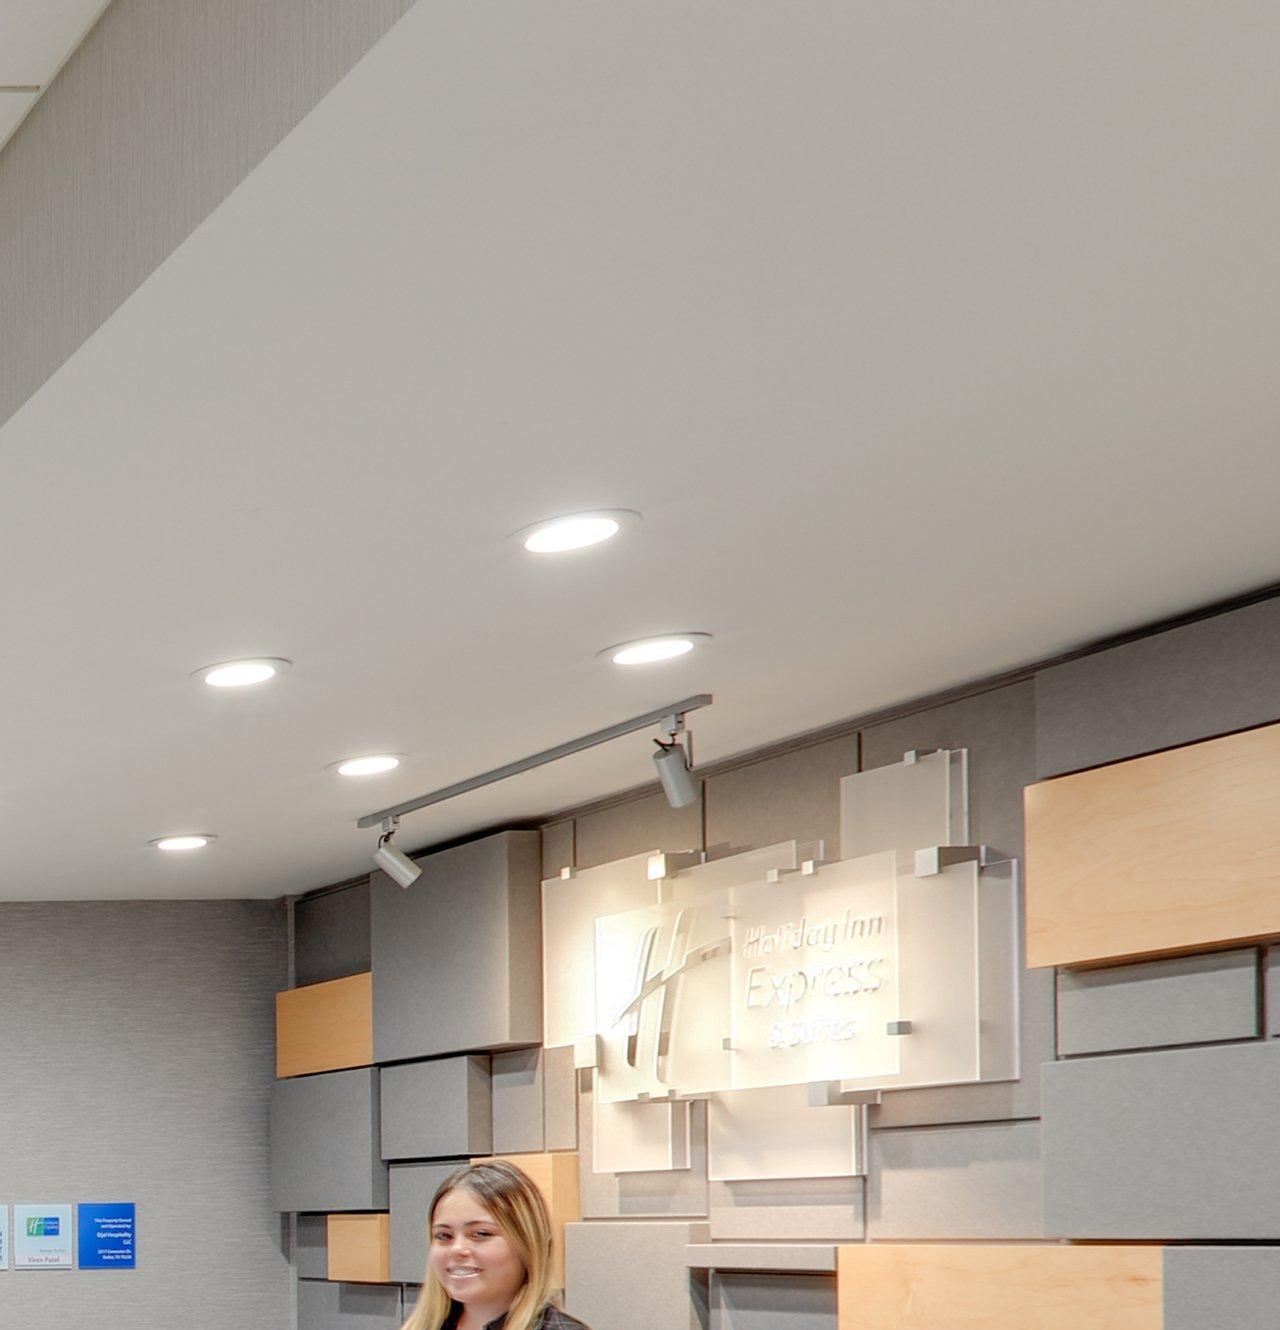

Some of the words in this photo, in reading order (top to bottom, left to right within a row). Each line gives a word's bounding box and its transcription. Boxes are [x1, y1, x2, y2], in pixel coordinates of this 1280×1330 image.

[742, 918, 838, 959] Holiday
[843, 909, 884, 940] Inn
[746, 957, 885, 1014] Express
